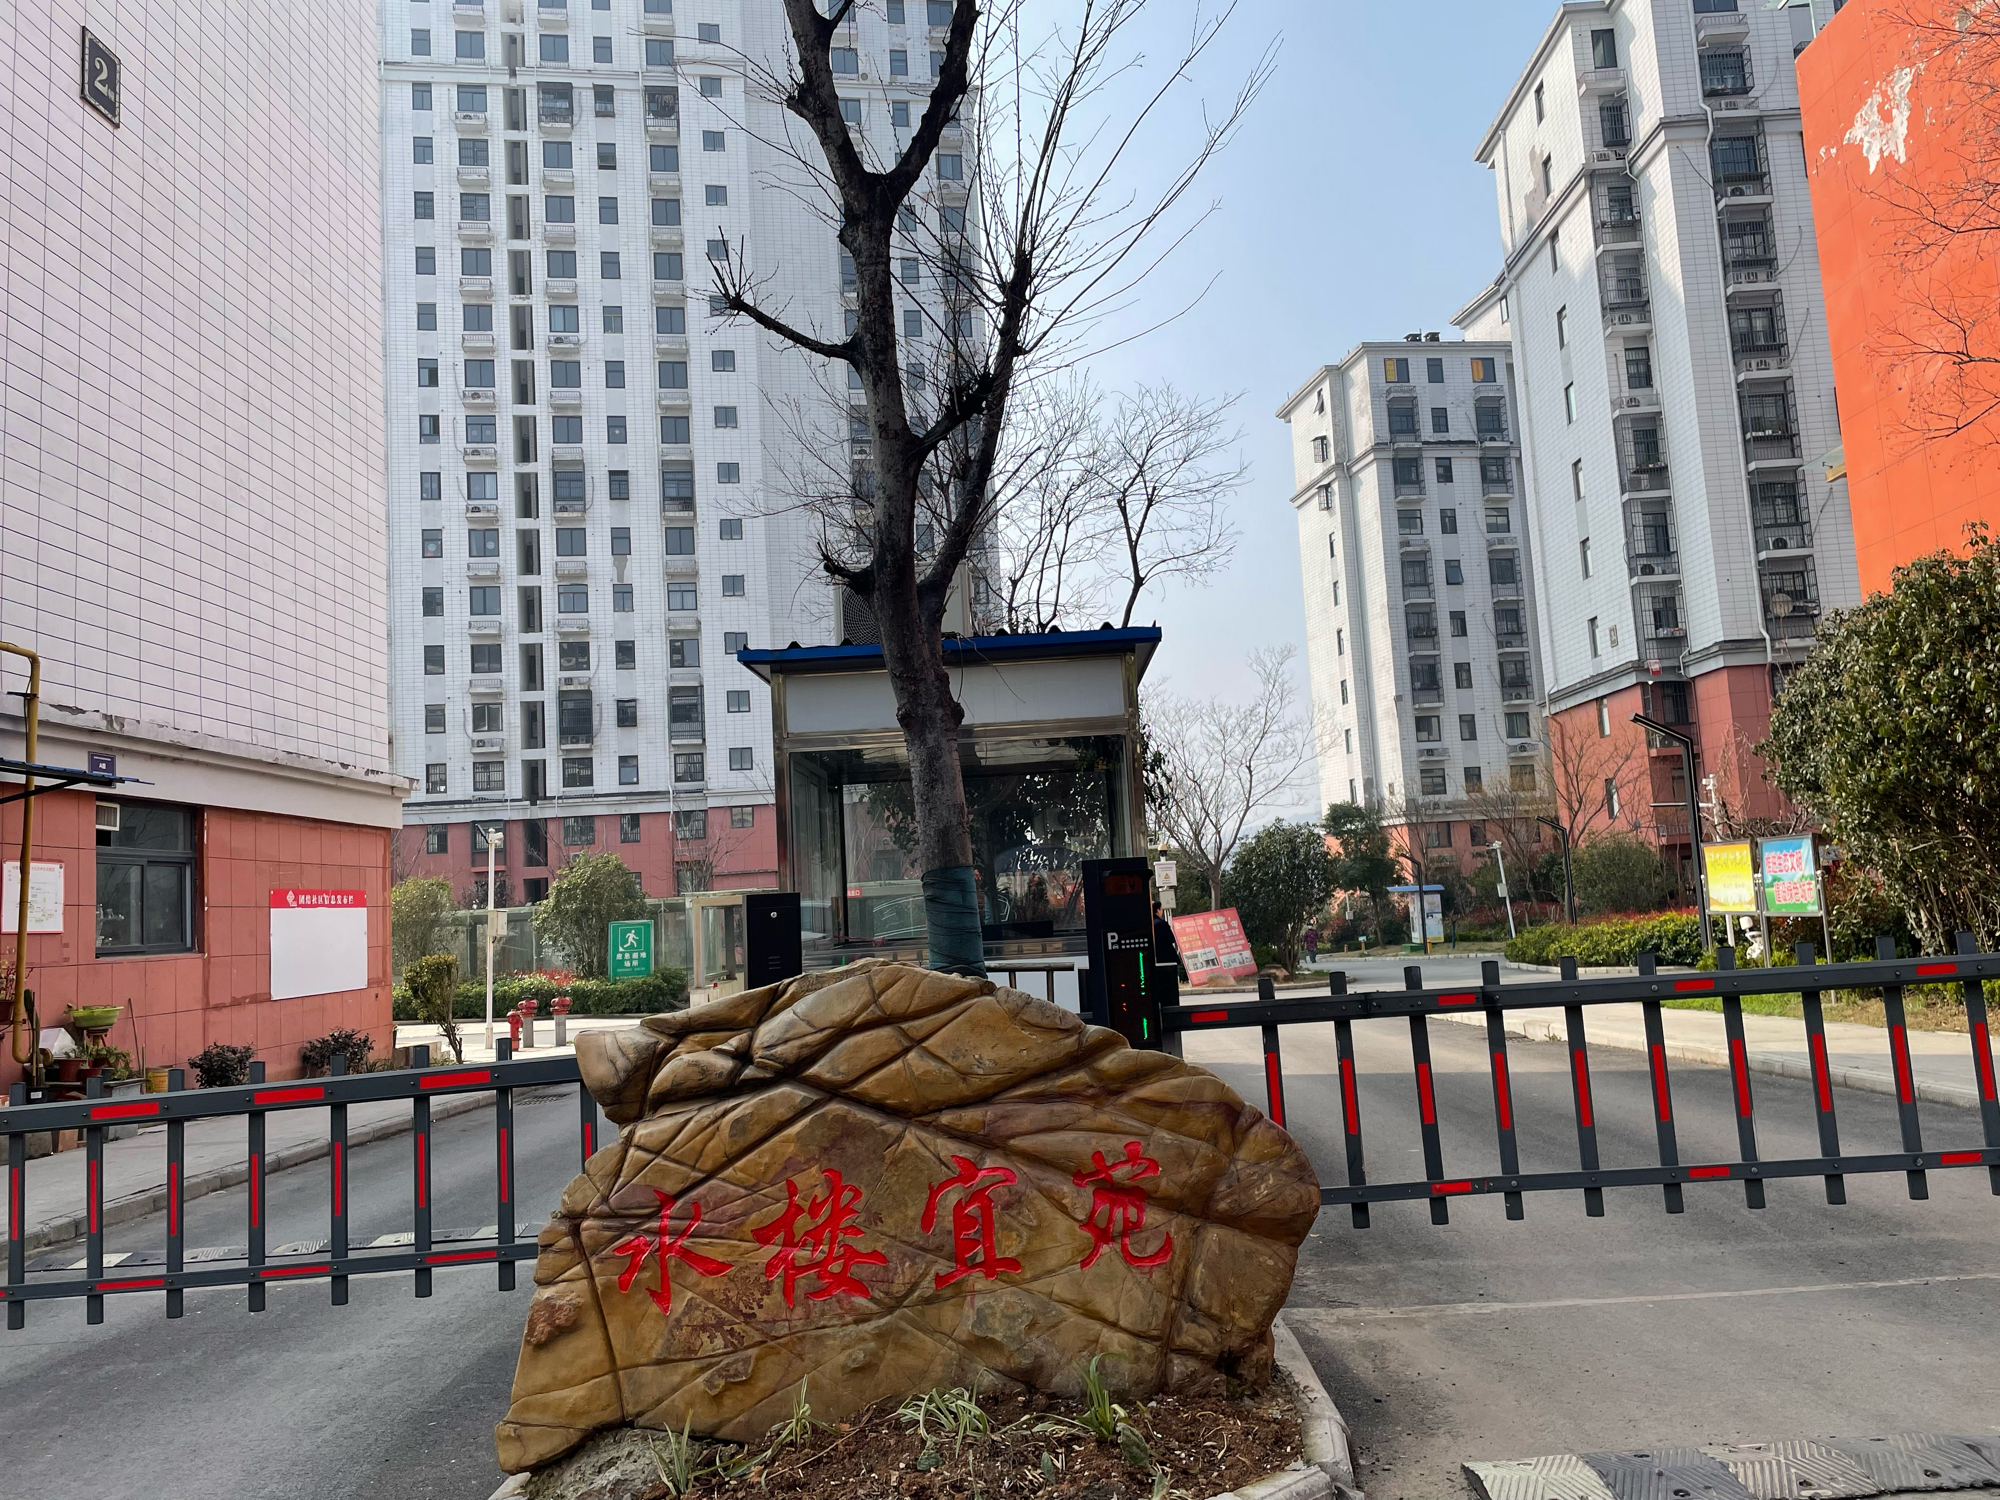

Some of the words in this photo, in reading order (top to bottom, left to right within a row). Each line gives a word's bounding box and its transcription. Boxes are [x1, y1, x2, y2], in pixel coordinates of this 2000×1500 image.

[1765, 849, 1803, 874] 推进生态文明
[1773, 879, 1815, 904] 建设绿色城市
[616, 952, 647, 960] 应急避难
[613, 1141, 1173, 1316] 水楼宜苑
